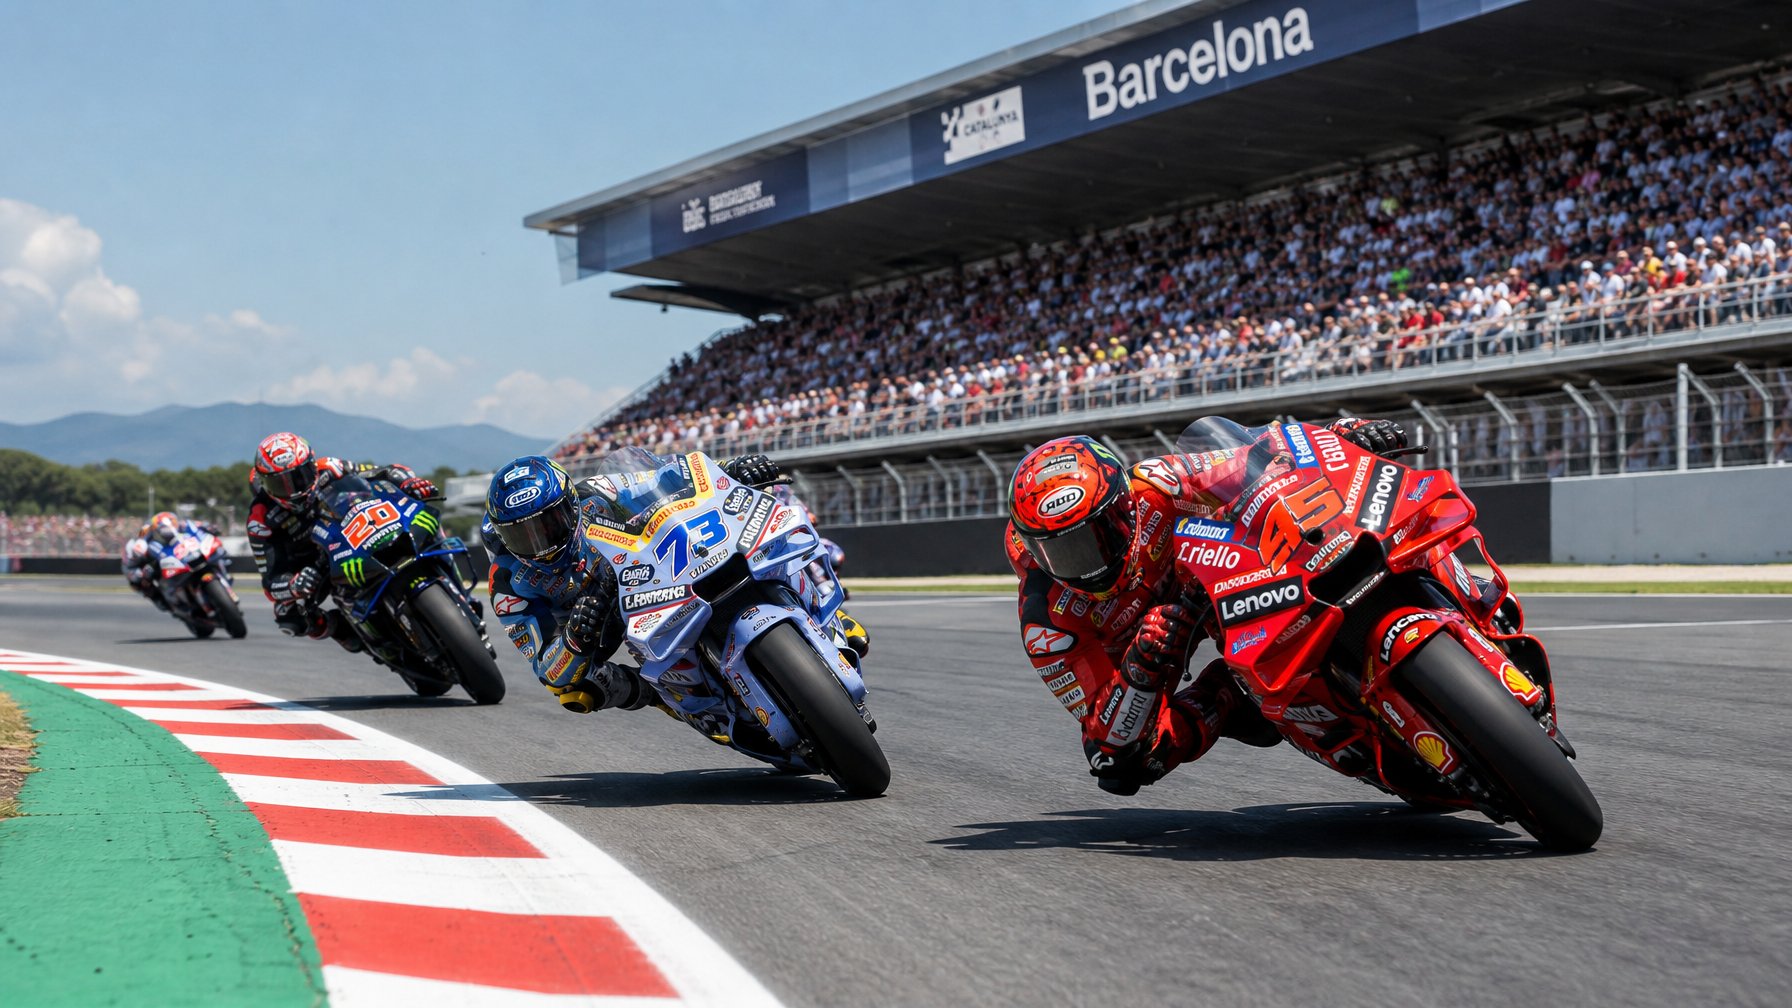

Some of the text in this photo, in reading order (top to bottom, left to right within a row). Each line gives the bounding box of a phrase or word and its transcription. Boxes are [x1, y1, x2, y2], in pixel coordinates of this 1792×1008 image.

[1083, 7, 1314, 121] Barcelona
[341, 500, 401, 551] 20
[1258, 474, 1347, 576] 45
[1361, 464, 1398, 527] Lenovo
[654, 506, 730, 582] 73
[1221, 584, 1300, 620] Lenovo
